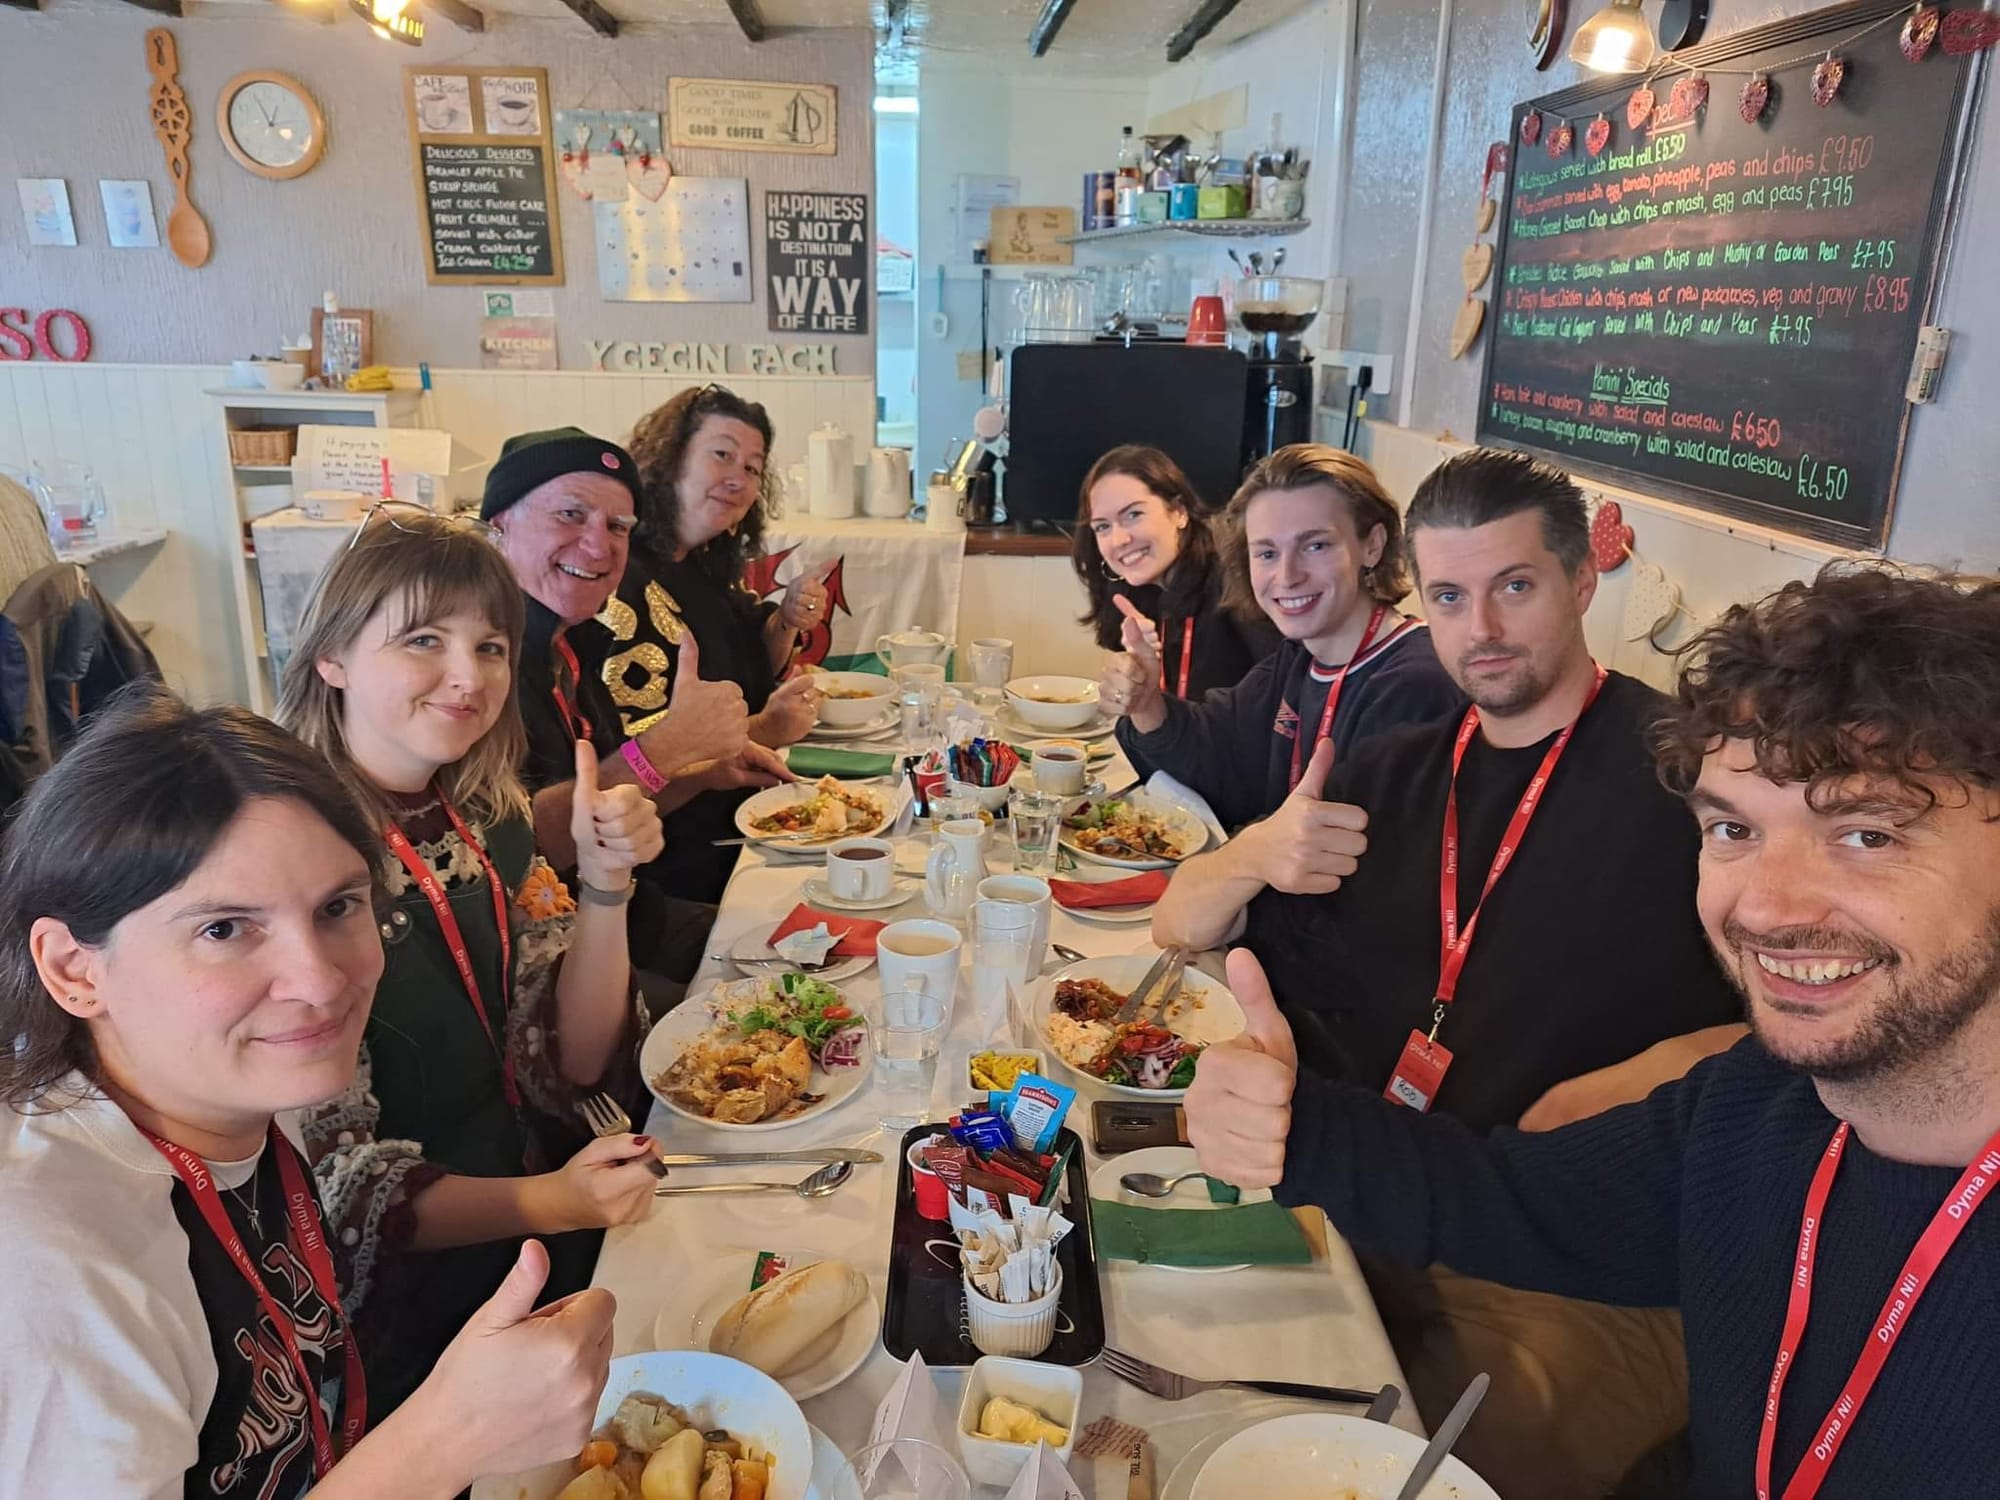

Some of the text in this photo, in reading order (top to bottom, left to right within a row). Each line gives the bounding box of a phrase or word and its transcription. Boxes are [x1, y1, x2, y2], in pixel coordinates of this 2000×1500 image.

[688, 123, 765, 140] GOOD COFFEE
[1609, 145, 1634, 170] bread
[1705, 158, 1736, 190] peas
[1743, 149, 1768, 177] and
[1773, 146, 1815, 183] chips
[767, 193, 865, 221] HAPPINESS
[1610, 204, 1631, 225] with
[1633, 200, 1658, 223] chips
[1662, 201, 1674, 214] or
[1712, 191, 1736, 216] egg
[1742, 186, 1765, 206] and
[1770, 184, 1803, 211] peas
[767, 220, 864, 242] IS NOT A
[780, 241, 853, 257] DESTINATION
[795, 258, 839, 279] IT IS A
[1663, 248, 1691, 272] Chips
[1697, 246, 1714, 268] and
[1774, 240, 1809, 263] Garden
[1817, 239, 1841, 261] Peas
[771, 275, 862, 316] WAY
[1657, 286, 1673, 305] or
[1676, 284, 1699, 304] new
[1761, 287, 1784, 313] veg
[1789, 281, 1814, 305] and
[1816, 284, 1858, 320] gravy
[777, 314, 857, 331] OF LIFE
[1663, 309, 1694, 338] Chips
[1700, 313, 1724, 337] and
[1731, 311, 1759, 336] Peas
[587, 340, 615, 372] Y
[743, 342, 839, 376] FACH
[1624, 365, 1672, 400] Specials
[1613, 404, 1641, 425] salad
[1643, 406, 1668, 428] and
[1671, 410, 1726, 433] coleslaw
[1577, 422, 1594, 441] and
[1594, 426, 1641, 458] cranberry
[1647, 430, 1671, 456] with
[1674, 439, 1706, 463] salad
[1706, 443, 1731, 468] and
[1732, 451, 1793, 482] coleslaw
[1797, 453, 1849, 501] £6.50
[178, 1150, 208, 1191] Dyma
[291, 1192, 313, 1232] Dyma
[1946, 1174, 1986, 1221] Dyma
[1800, 1216, 1816, 1262] Dyma
[1877, 1271, 1921, 1344] Dyma Ni!
[1813, 1393, 1855, 1461] Dyma Ni!
